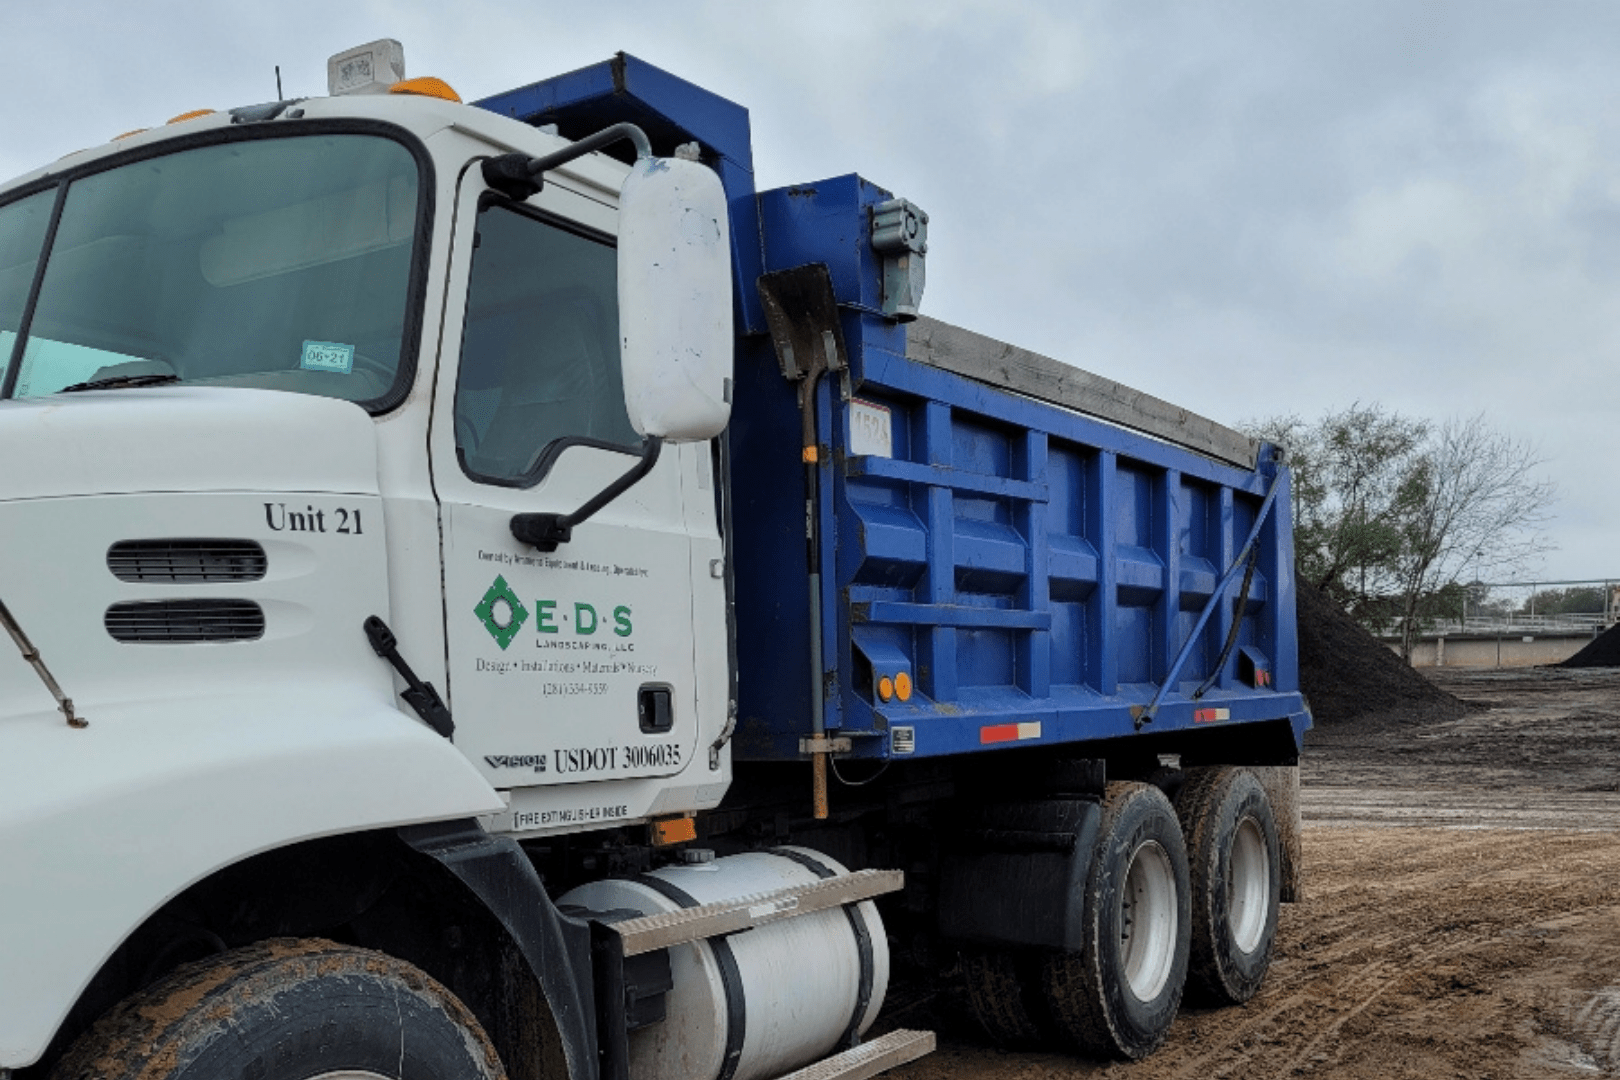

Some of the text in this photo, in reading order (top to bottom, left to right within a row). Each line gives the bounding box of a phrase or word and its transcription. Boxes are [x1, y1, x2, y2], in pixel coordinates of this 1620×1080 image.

[264, 503, 363, 535] Unit 21
[554, 744, 682, 774] USDOT 3006035
[520, 805, 628, 825] FIRE EXTINGUISHER INSIDE
